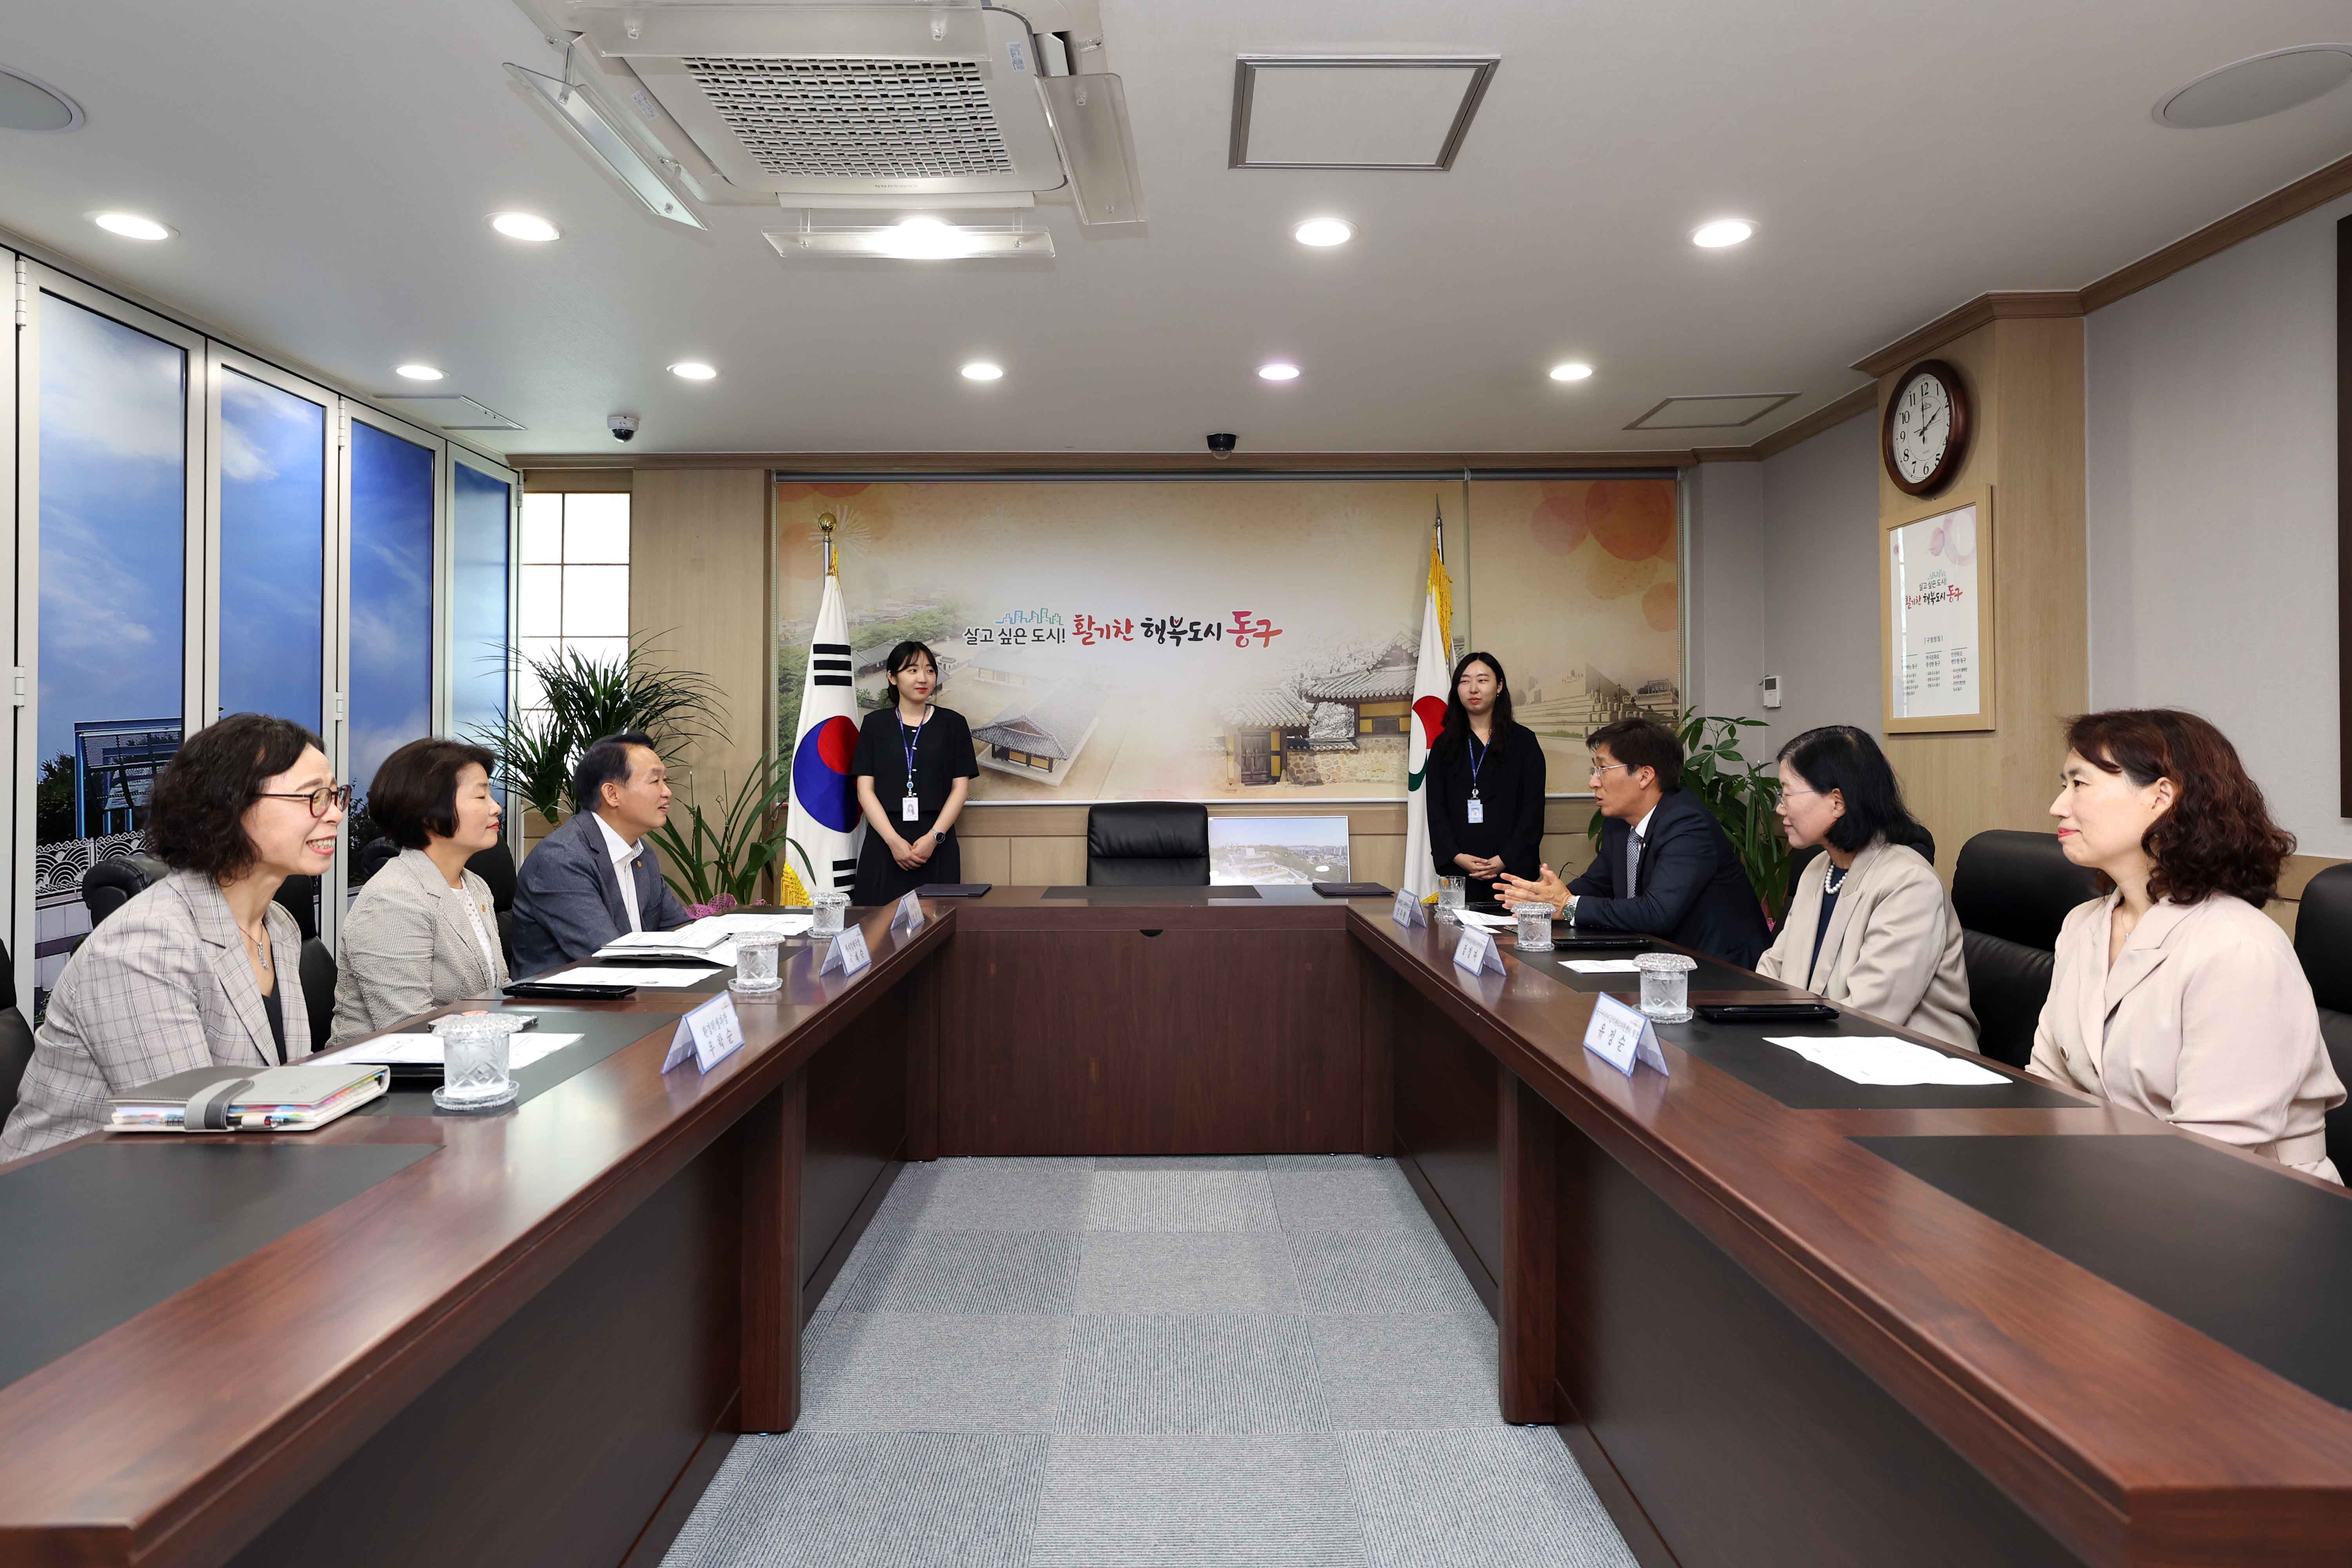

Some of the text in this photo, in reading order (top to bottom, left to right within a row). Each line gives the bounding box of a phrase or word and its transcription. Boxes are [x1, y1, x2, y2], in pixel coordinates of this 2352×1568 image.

[1921, 382, 1929, 396] 12
[1936, 383, 1939, 396] 1
[1909, 393, 1916, 407] 11
[1944, 395, 1949, 408] 2
[1902, 410, 1910, 424] 10
[1900, 430, 1906, 443] 9
[1903, 448, 1909, 462] 8
[1935, 453, 1941, 467] 5
[1911, 461, 1916, 474] 7
[1923, 461, 1929, 475] 6
[1919, 583, 1927, 591] 살고
[1928, 580, 1936, 589] 싶은
[1905, 584, 1963, 609] 활기찬 행복도시 동구
[964, 611, 1283, 648] 살고 싶은 도시! 활기찬 행복도시 동구
